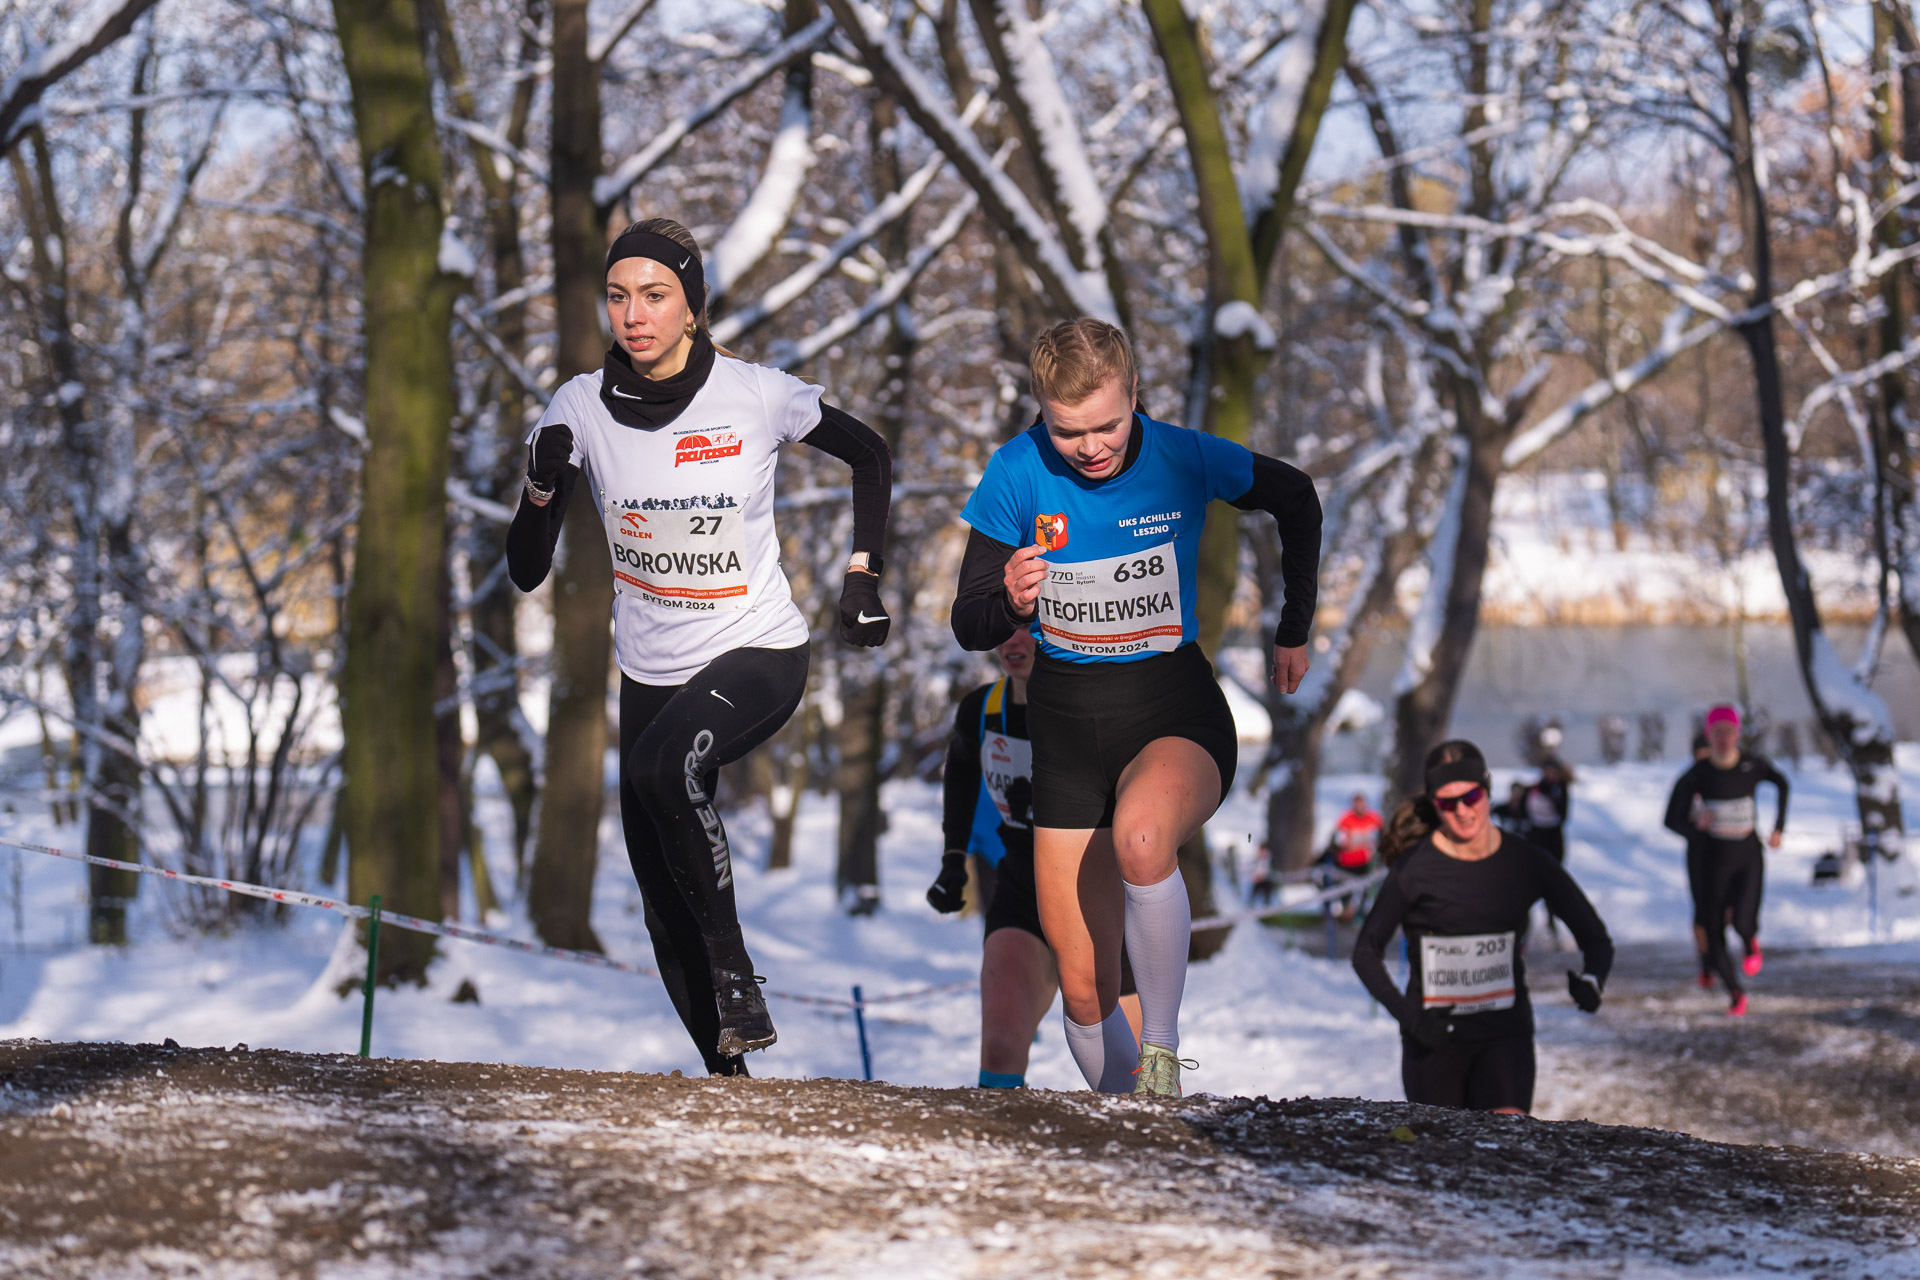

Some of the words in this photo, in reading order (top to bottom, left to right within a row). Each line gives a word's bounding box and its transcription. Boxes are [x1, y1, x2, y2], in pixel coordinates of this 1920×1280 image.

[675, 440, 742, 468] parasol
[620, 528, 652, 539] ORLEN
[689, 516, 722, 535] 27
[1118, 518, 1138, 528] UKS
[1139, 511, 1182, 524] ACHILLES
[1133, 525, 1169, 537] LESZNO
[613, 542, 741, 576] BOROWSKA
[1113, 555, 1165, 583] 638
[1050, 571, 1073, 581] 770
[642, 592, 683, 609] BYTOM
[685, 601, 715, 610] 2024
[1041, 591, 1174, 623] TEOFILEWSKA
[1120, 632, 1142, 641] Biegach
[1072, 643, 1116, 654] BYTOM
[1119, 641, 1149, 653] 2024
[684, 729, 714, 804] PRO
[695, 803, 733, 891] NIKE
[1475, 937, 1507, 957] 203
